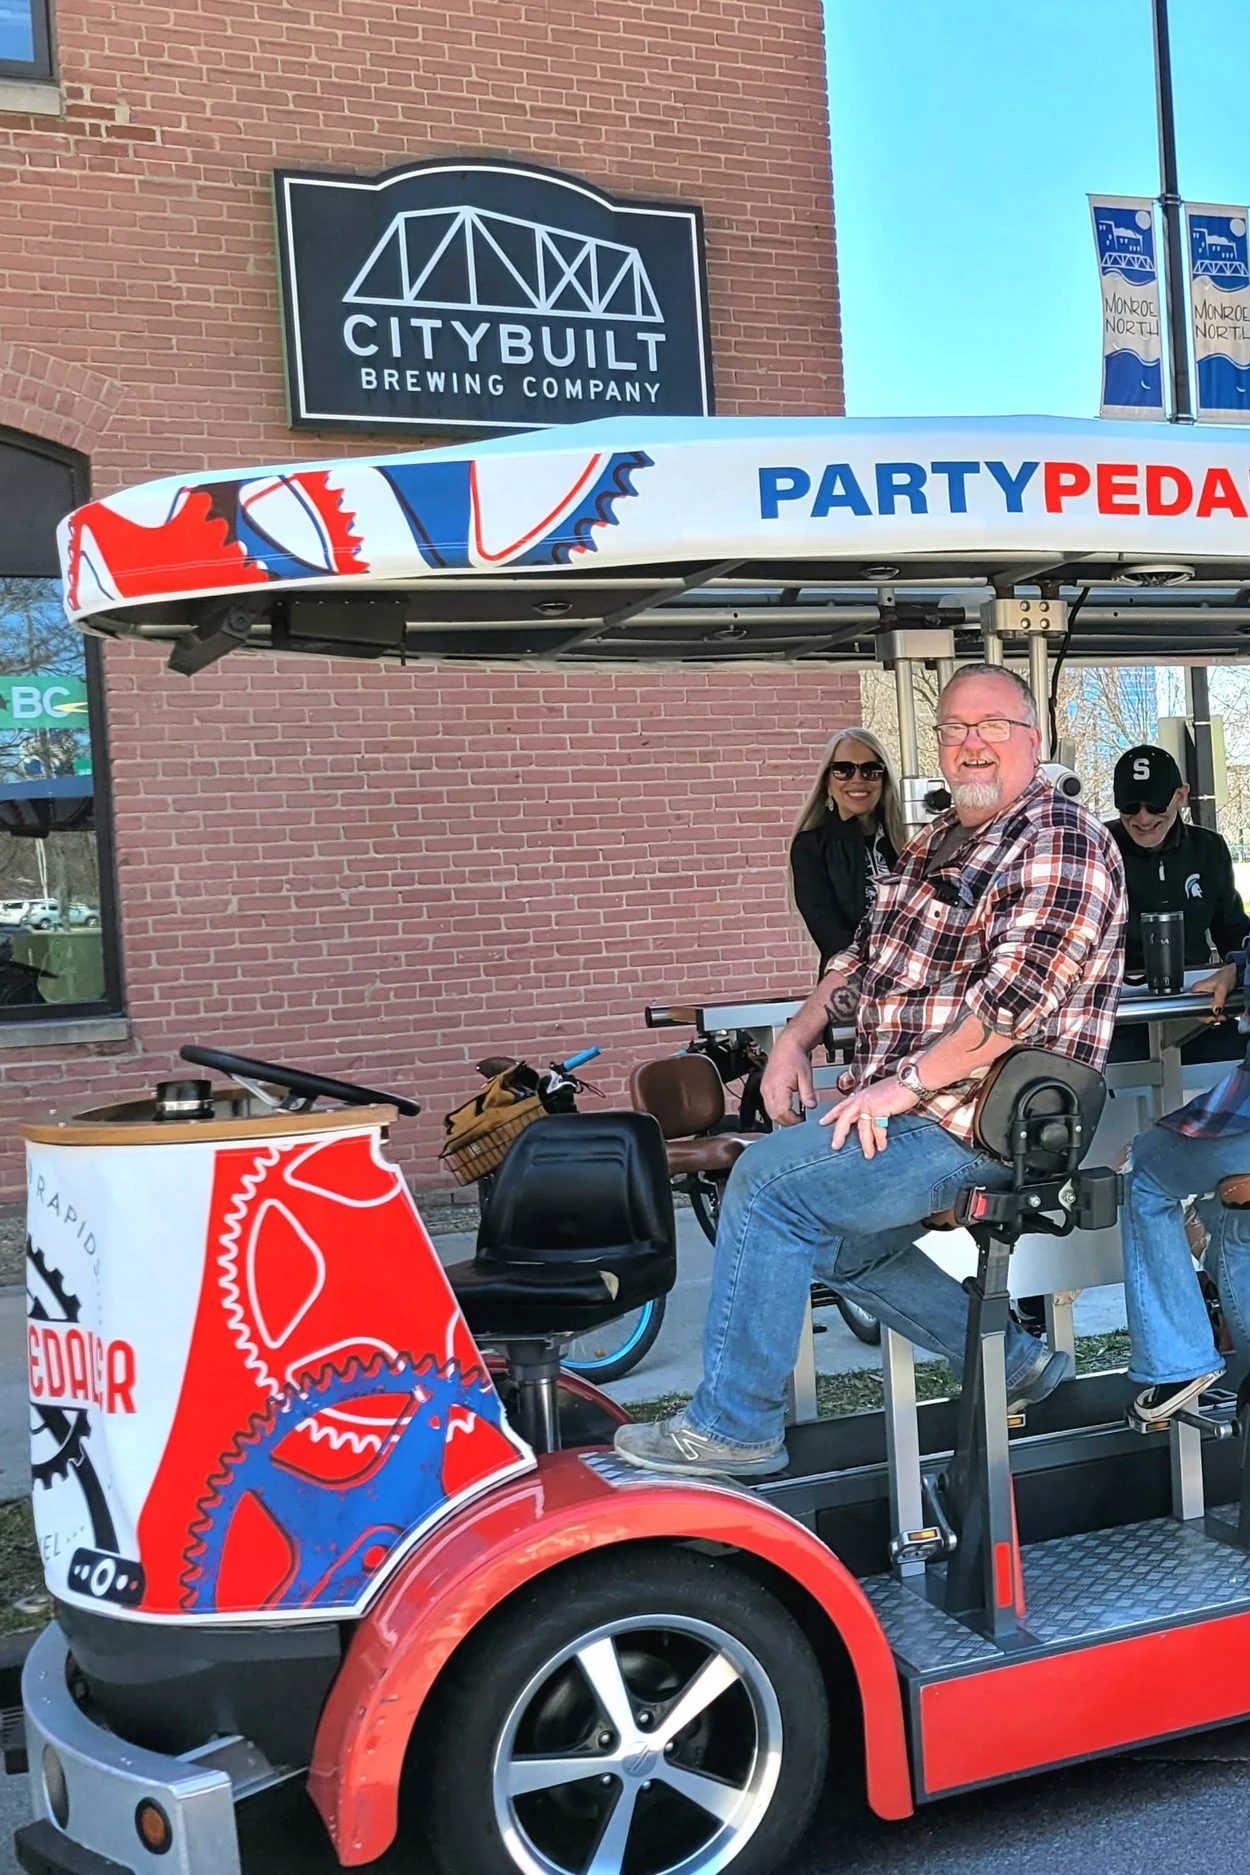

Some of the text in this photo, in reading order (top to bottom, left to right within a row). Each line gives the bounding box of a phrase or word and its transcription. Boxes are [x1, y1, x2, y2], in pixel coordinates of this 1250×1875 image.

[1105, 292, 1157, 317] MONROE
[1194, 299, 1250, 322] MONROE
[1106, 318, 1159, 337] NORTH
[343, 314, 666, 372] CITYBUILT
[361, 368, 661, 403] BREWING COMPANY
[1133, 758, 1150, 780] S
[28, 1324, 137, 1414] EDALER
